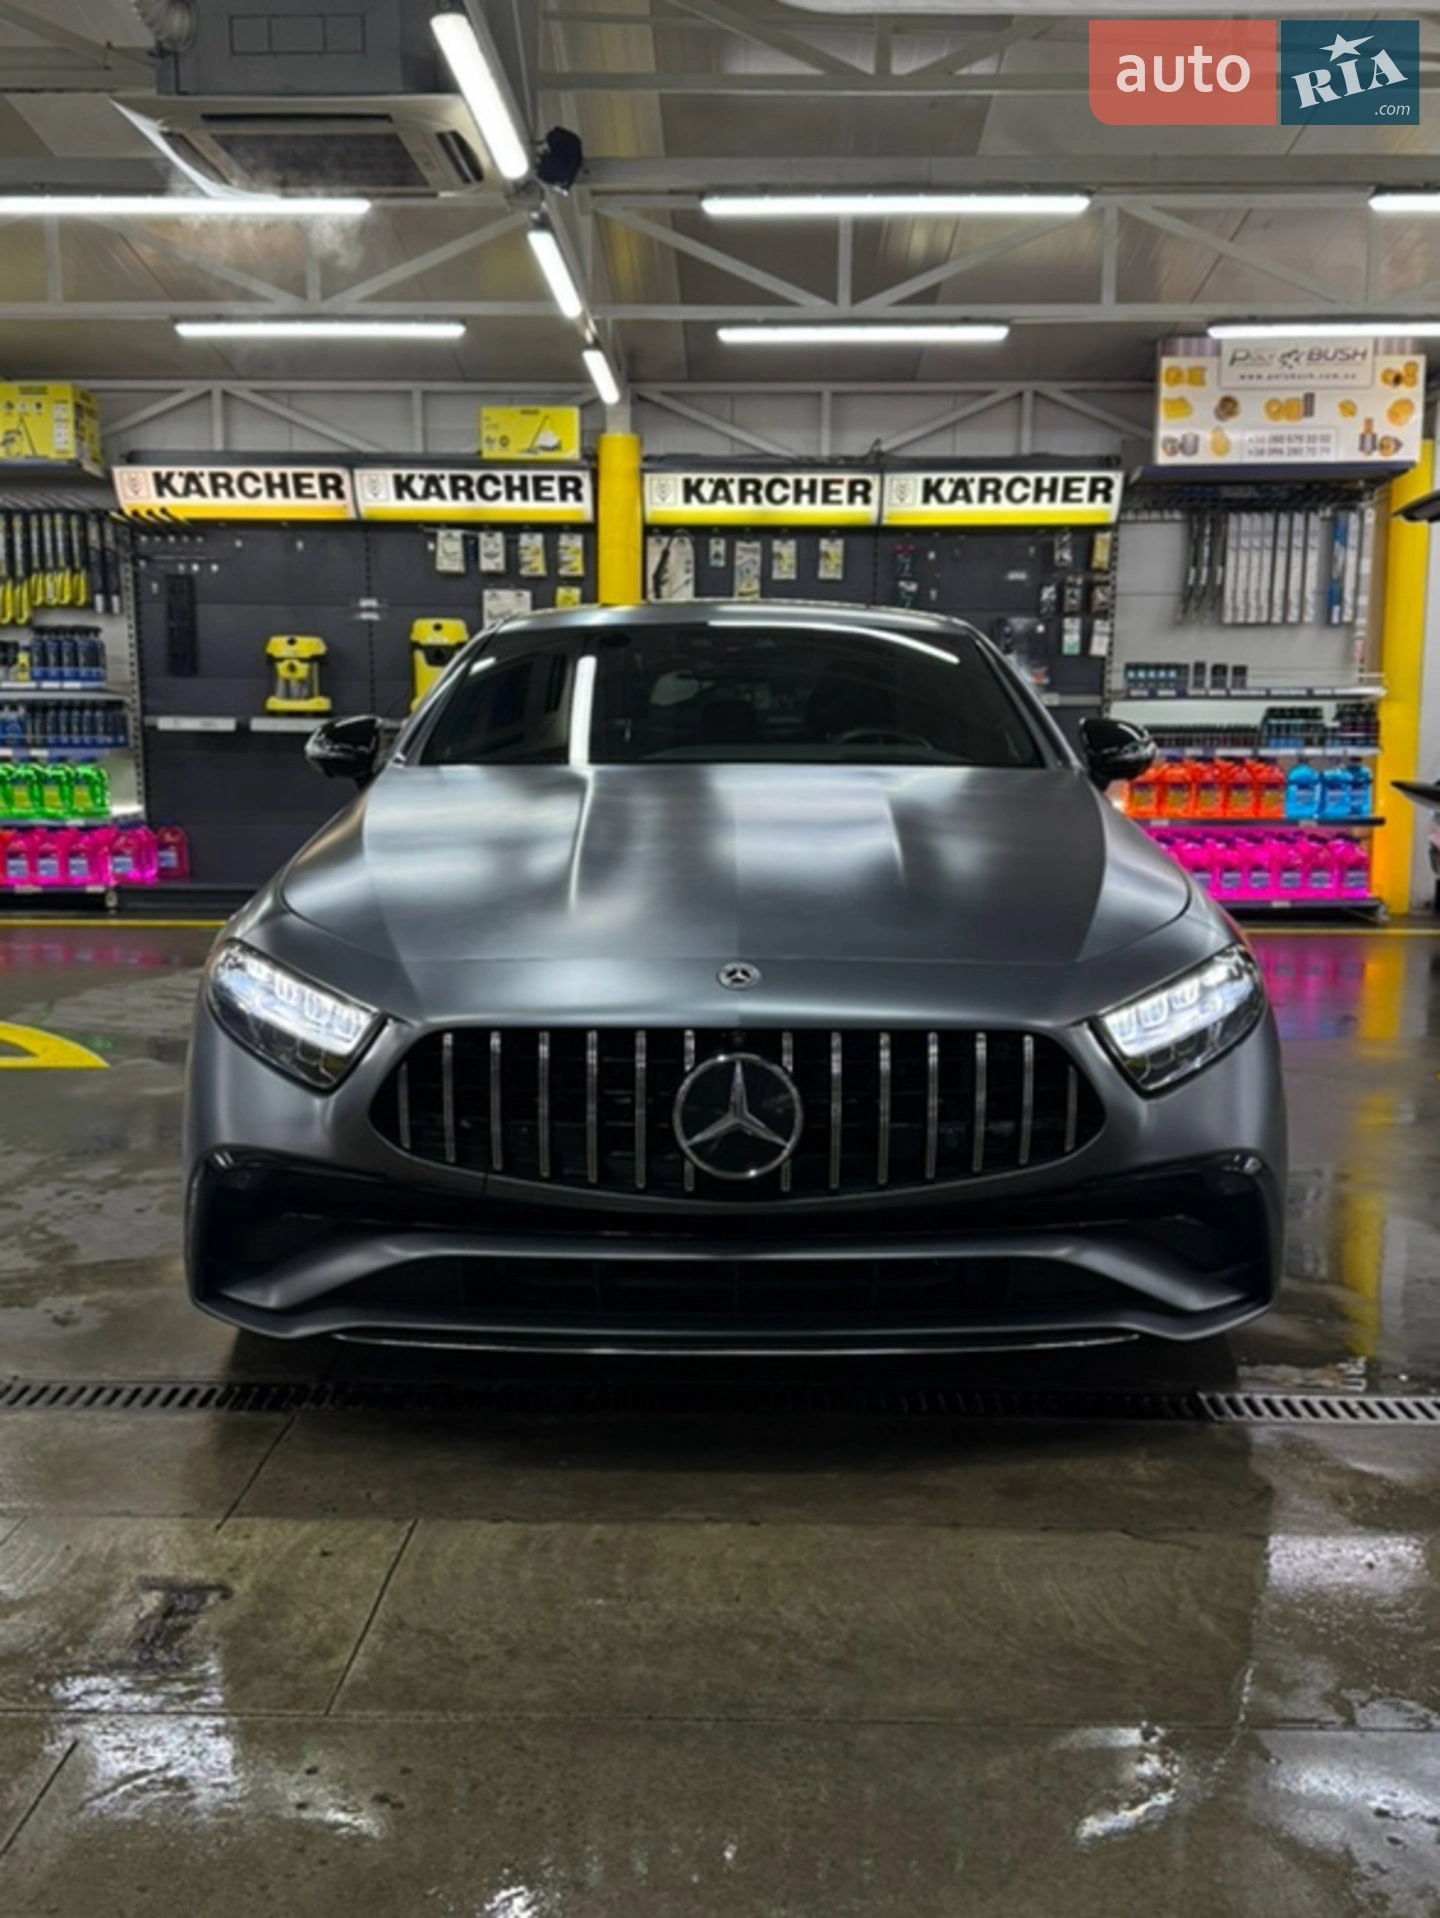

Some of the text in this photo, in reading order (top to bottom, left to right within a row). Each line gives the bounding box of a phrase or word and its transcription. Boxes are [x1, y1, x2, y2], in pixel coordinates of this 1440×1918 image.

[152, 470, 346, 500] KÄRCHER
[392, 472, 584, 503] KÄRCHER
[682, 476, 873, 506] KÄRCHER
[921, 475, 1115, 505] KÄRCHER
